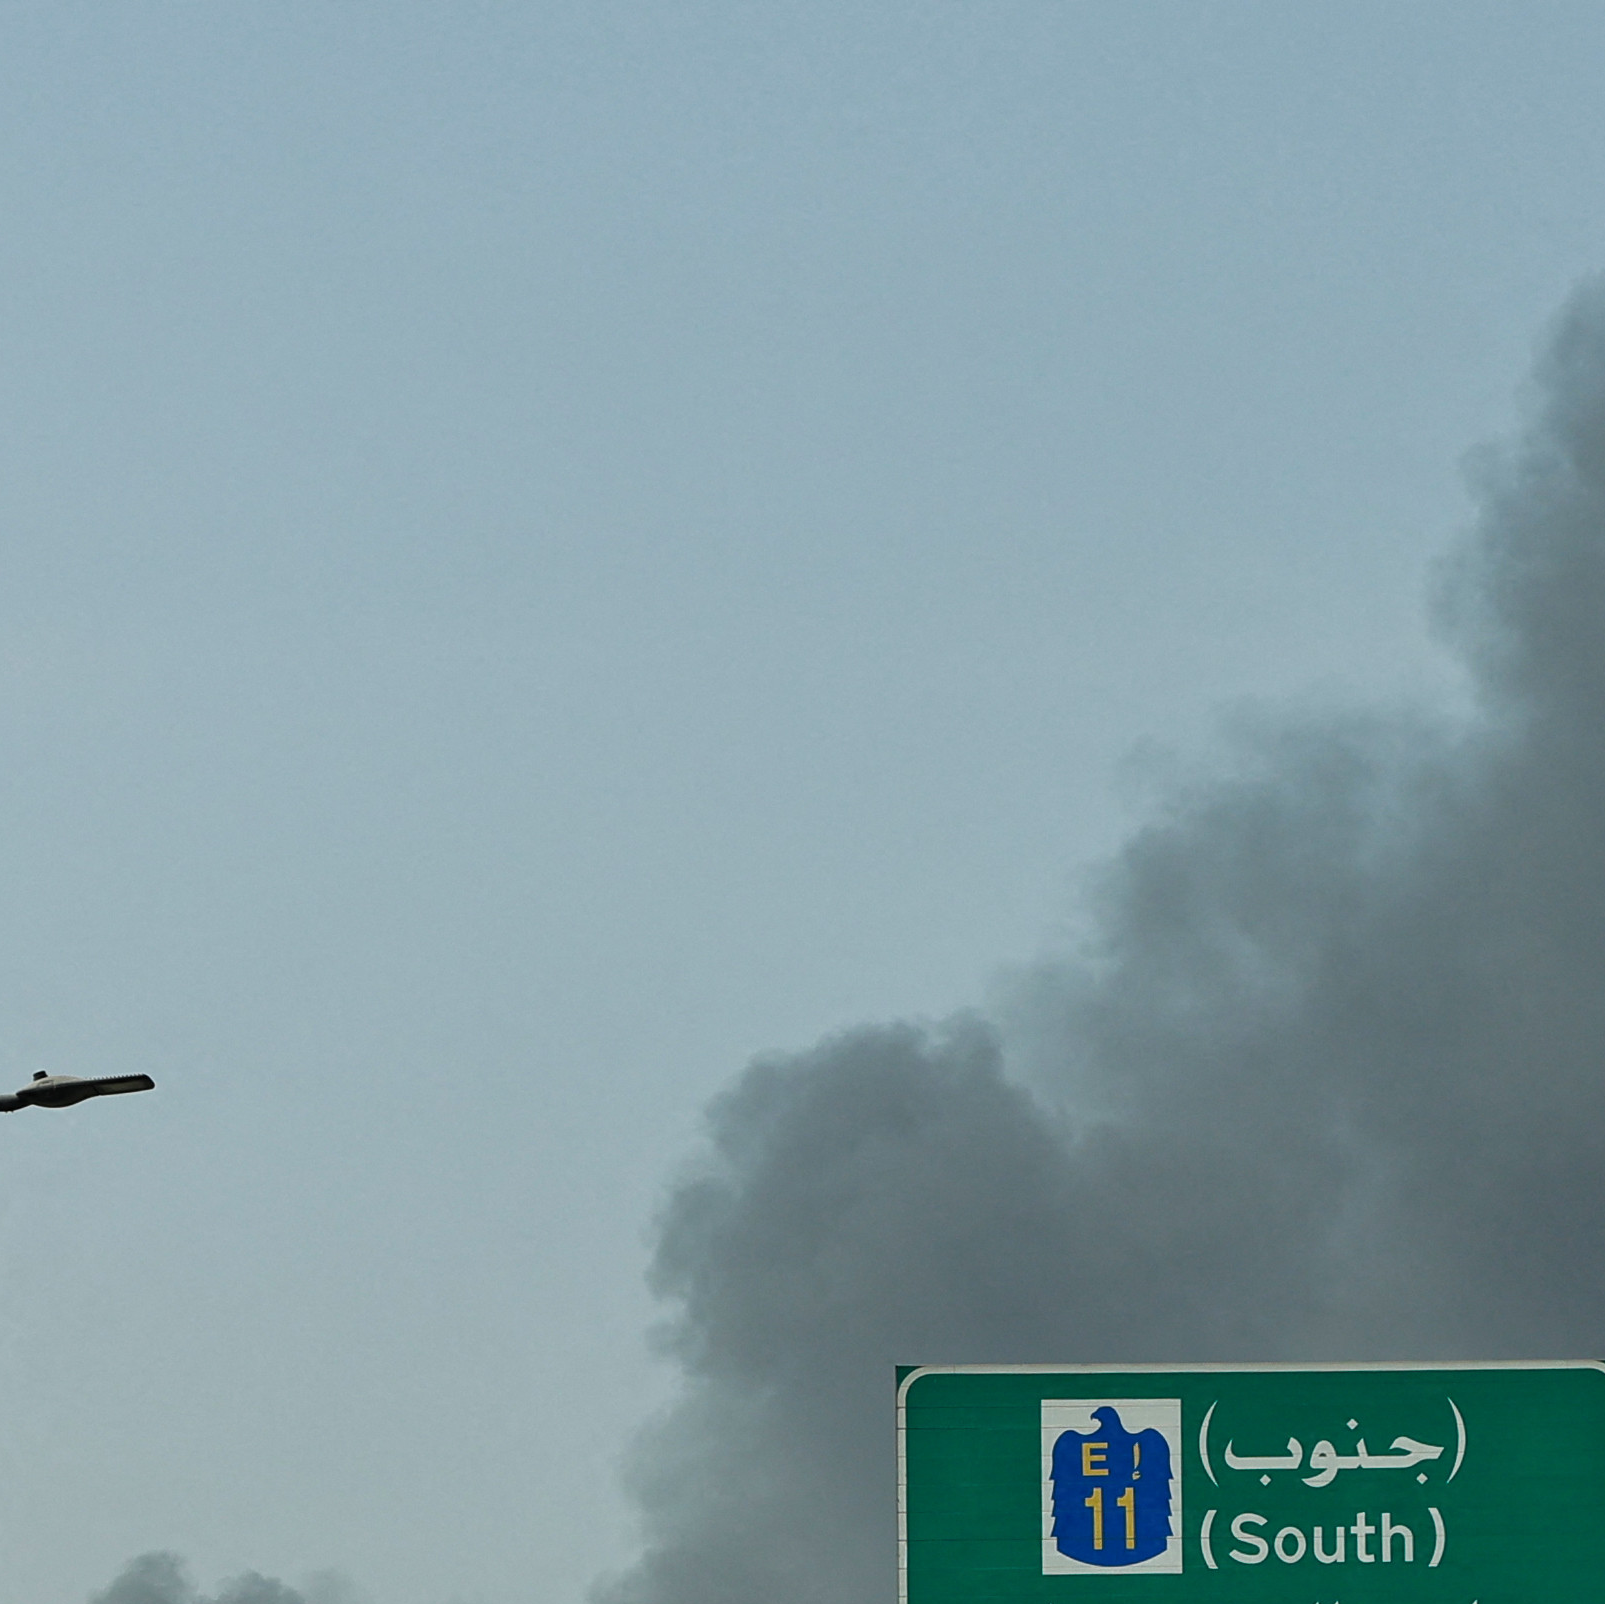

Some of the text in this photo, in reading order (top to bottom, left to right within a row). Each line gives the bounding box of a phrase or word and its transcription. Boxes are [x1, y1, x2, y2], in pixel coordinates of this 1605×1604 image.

[1082, 1442, 1109, 1476] E
[1199, 1398, 1466, 1487] (جنوب)
[1085, 1487, 1136, 1549] 11
[1200, 1508, 1445, 1570] (South)
